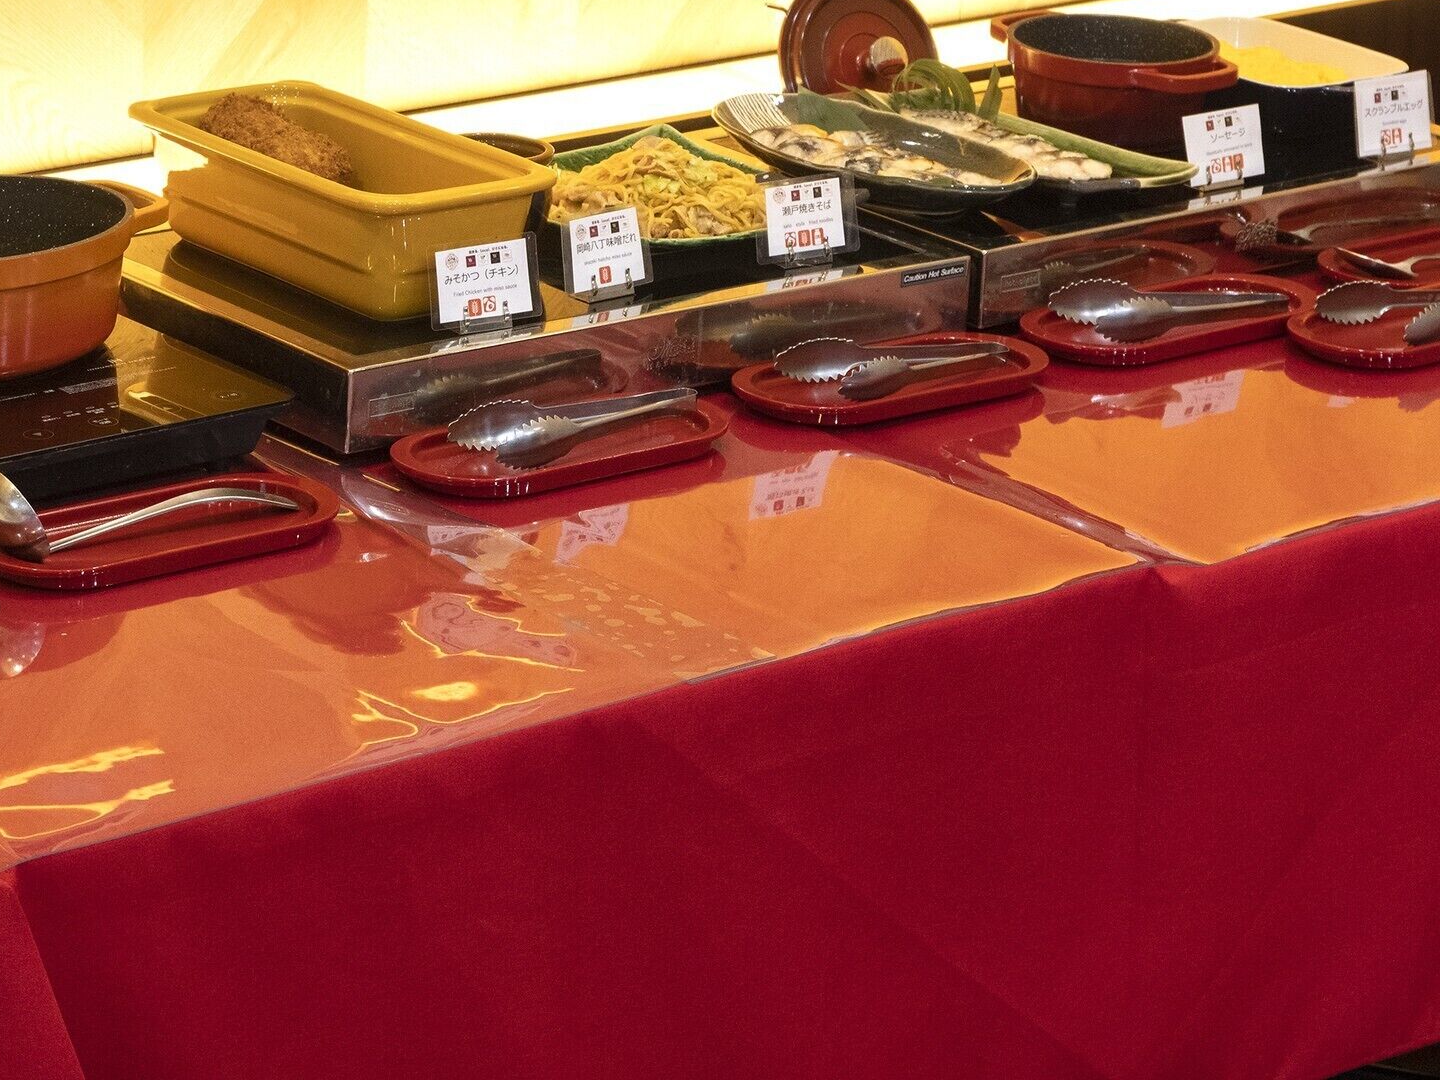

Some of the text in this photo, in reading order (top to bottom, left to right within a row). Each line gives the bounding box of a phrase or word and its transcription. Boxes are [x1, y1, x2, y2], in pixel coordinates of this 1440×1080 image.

[1210, 127, 1246, 143] ソーセージ
[782, 200, 832, 216] 瀬戸焼きそば
[904, 266, 964, 283] Caution Hot Surface
